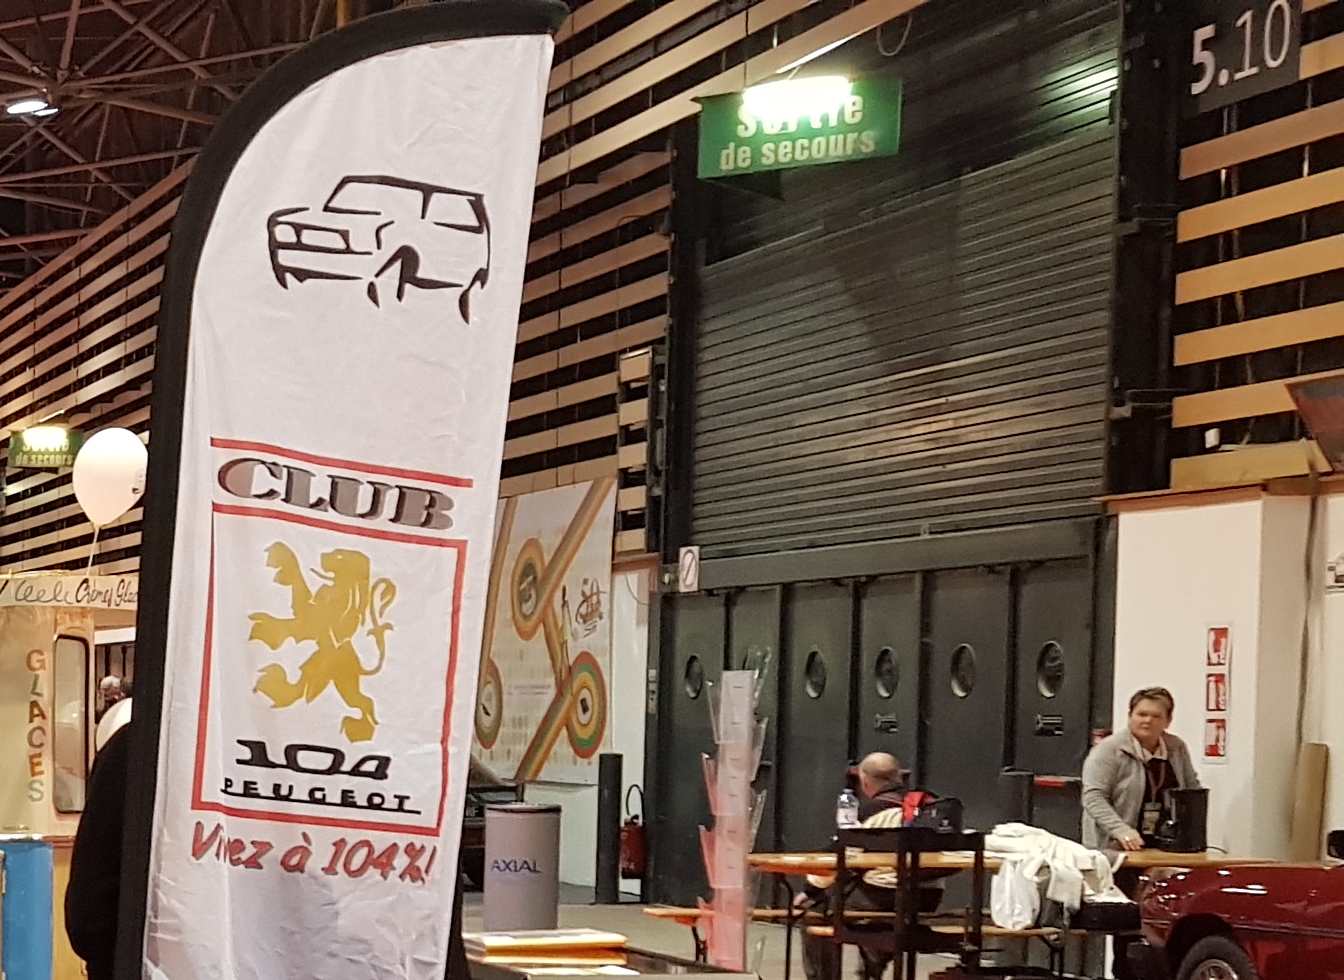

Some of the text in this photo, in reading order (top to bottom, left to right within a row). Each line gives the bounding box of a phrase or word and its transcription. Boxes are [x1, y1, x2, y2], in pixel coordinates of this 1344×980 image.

[1191, 0, 1290, 95] 5.10
[719, 129, 877, 171] de secours
[217, 457, 455, 530] CLUB
[25, 648, 47, 802] GLACES
[235, 738, 393, 781] 104
[223, 777, 413, 812] PEUGEOT
[279, 831, 313, 874] à
[491, 859, 542, 873] AXIAL
